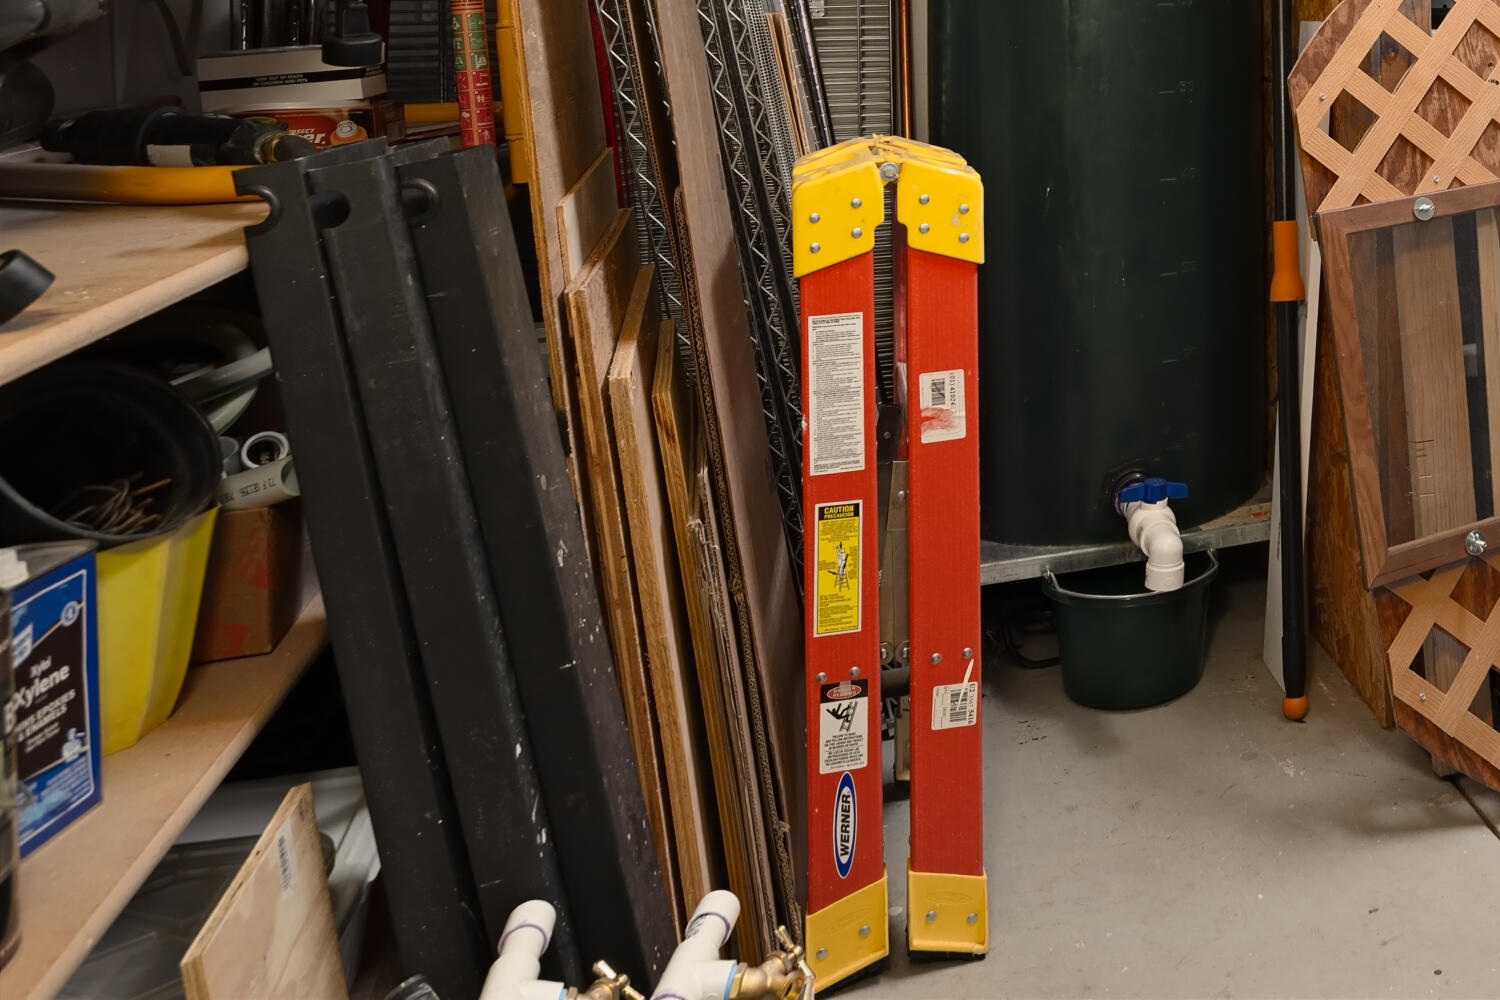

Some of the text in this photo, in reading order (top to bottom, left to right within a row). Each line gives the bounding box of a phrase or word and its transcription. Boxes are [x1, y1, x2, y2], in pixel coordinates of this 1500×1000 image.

[824, 505, 854, 515] CAUTION
[15, 665, 70, 709] Xylene
[839, 793, 851, 857] WERNER
